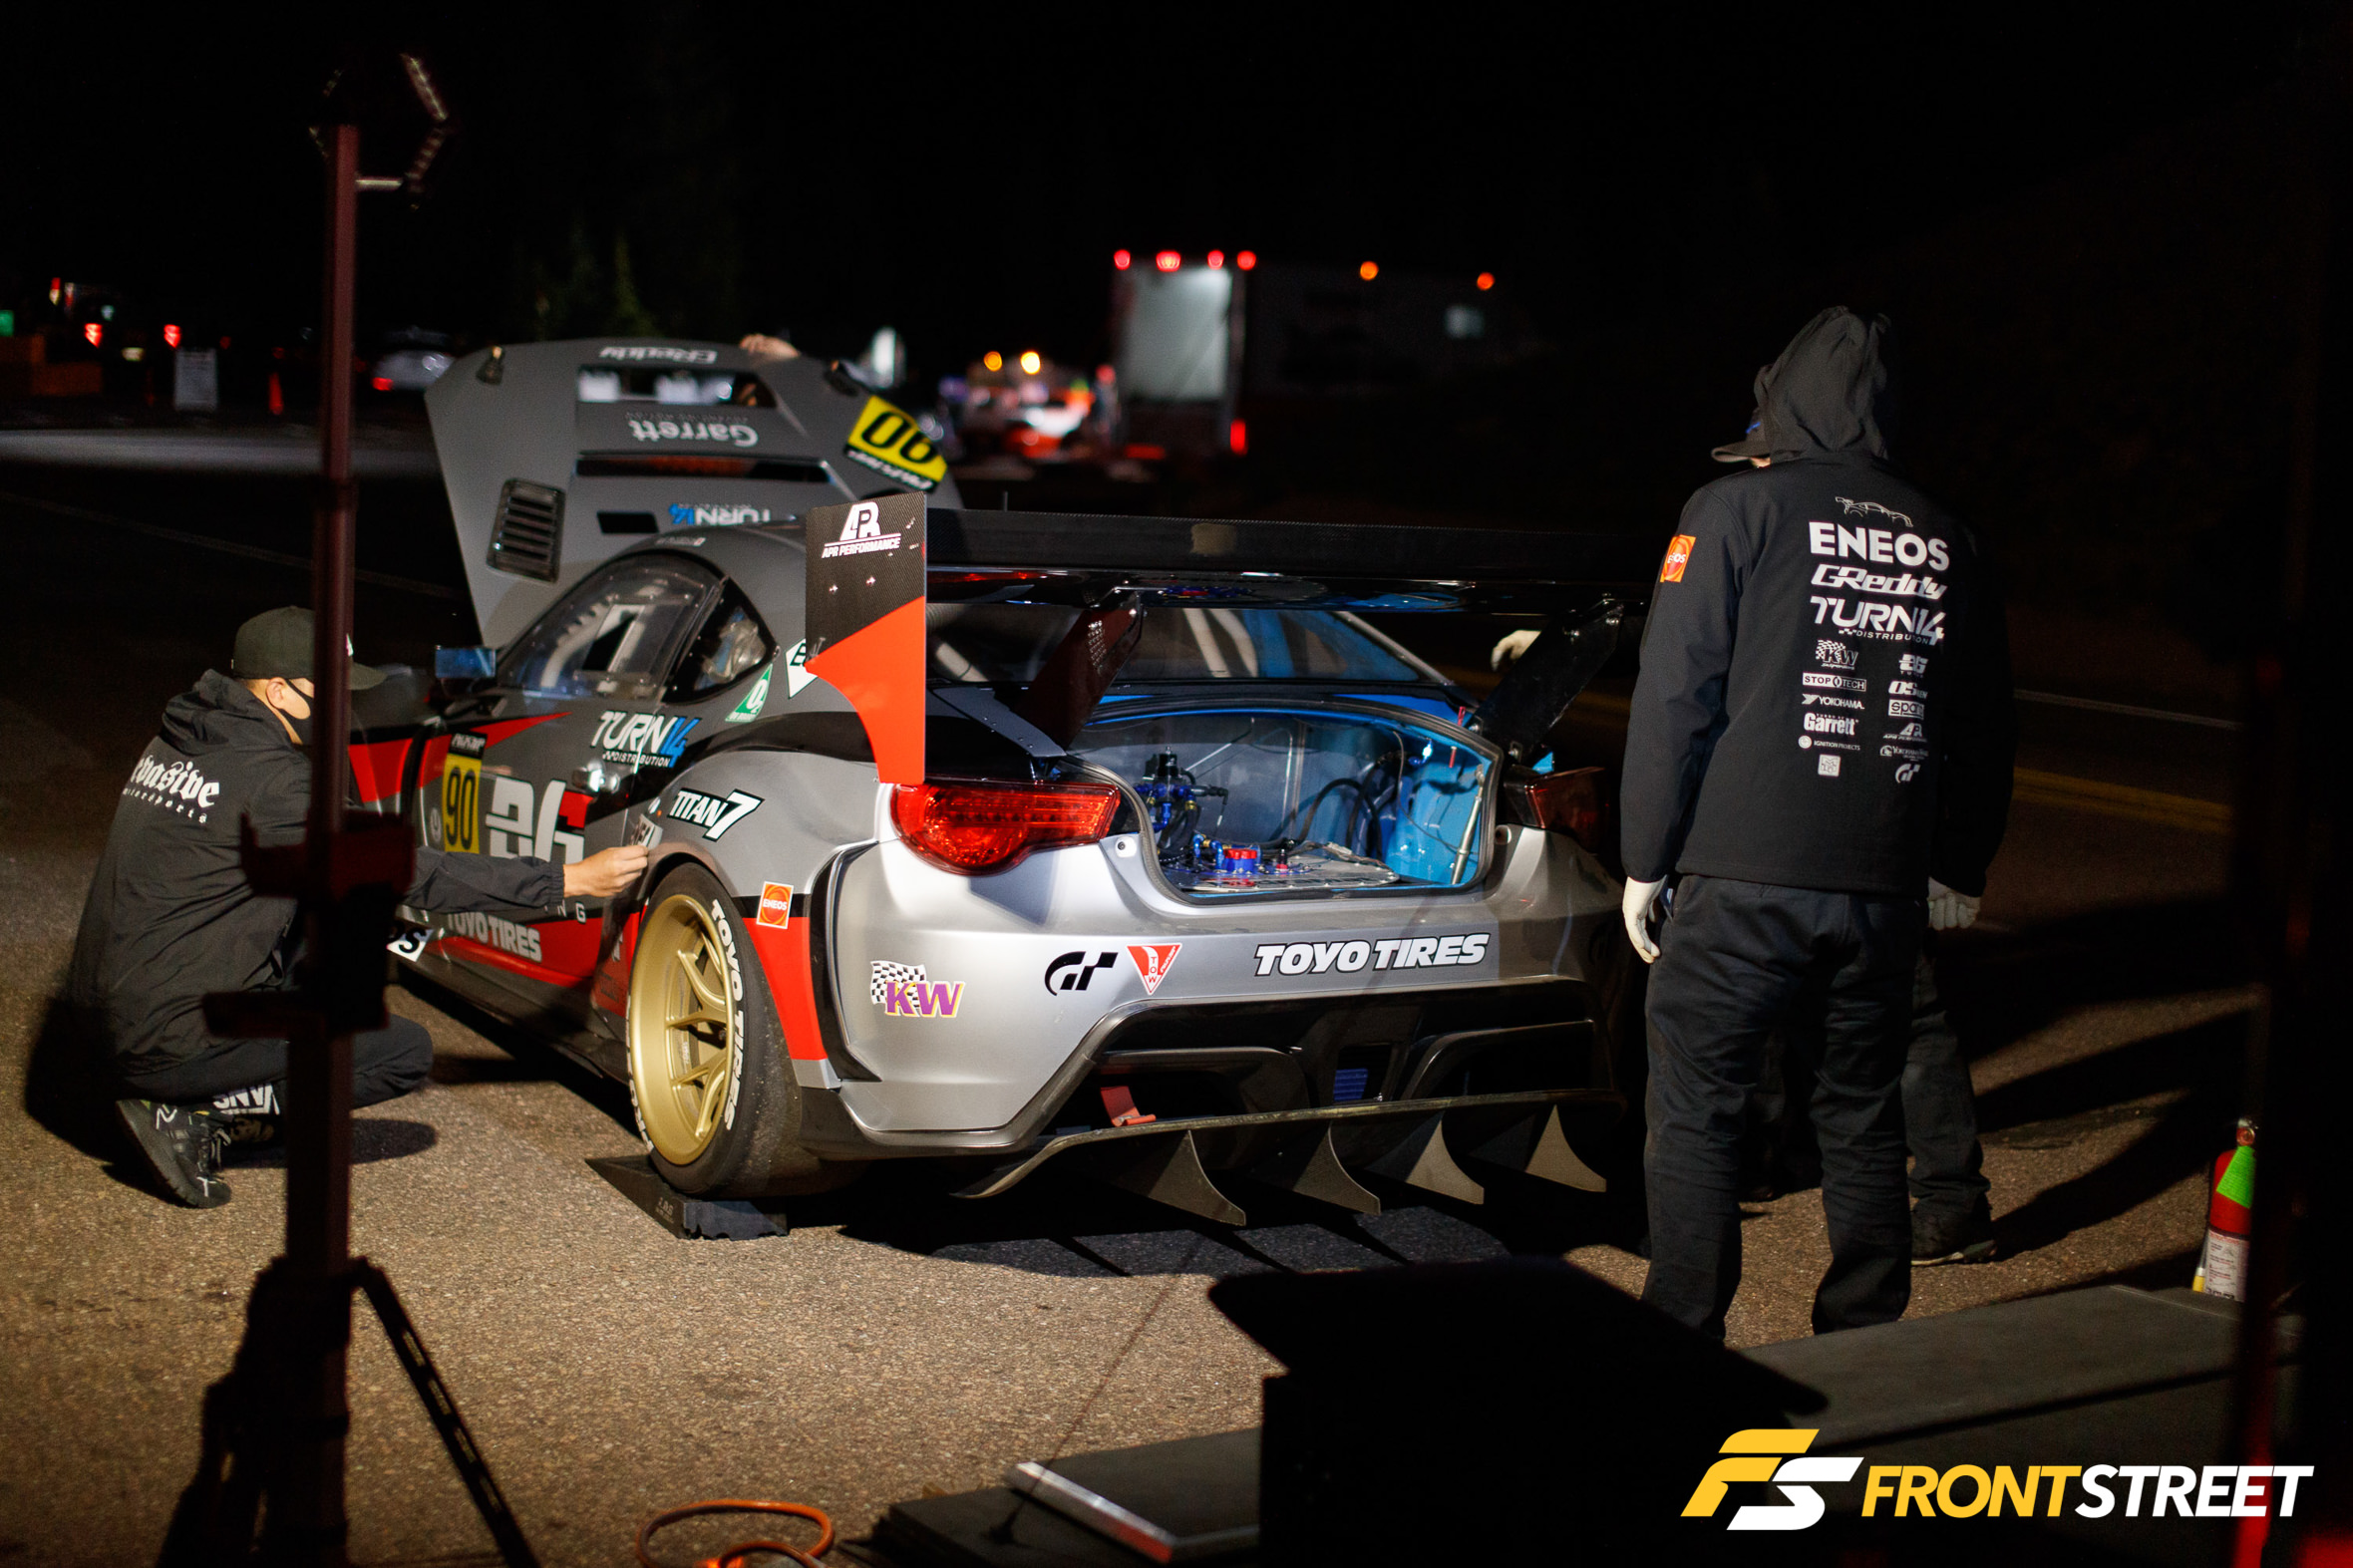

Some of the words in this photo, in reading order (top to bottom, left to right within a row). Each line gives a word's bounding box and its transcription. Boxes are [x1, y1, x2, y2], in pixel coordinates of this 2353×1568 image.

[629, 421, 759, 448] Garrett
[822, 546, 840, 558] APR
[839, 536, 901, 557] PERFORMANCE
[1809, 521, 1950, 571] ENEOS
[1811, 563, 1947, 600] GReddy
[1810, 595, 1946, 646] TURN14
[1824, 648, 1859, 666] KW
[1804, 676, 1832, 685] STOP
[1843, 679, 1865, 690] TECH
[1818, 696, 1865, 710] YOKOHAMA
[590, 711, 701, 769] TURN14
[1803, 712, 1856, 737] Garrett
[445, 767, 478, 851] 90
[763, 898, 788, 911] ENEOS
[488, 915, 543, 964] TIRES
[711, 898, 745, 1002] TOYO
[1254, 940, 1372, 977] TOYO
[1372, 932, 1492, 972] TIRES
[884, 980, 966, 1018] KW
[724, 1008, 745, 1131] TIRES
